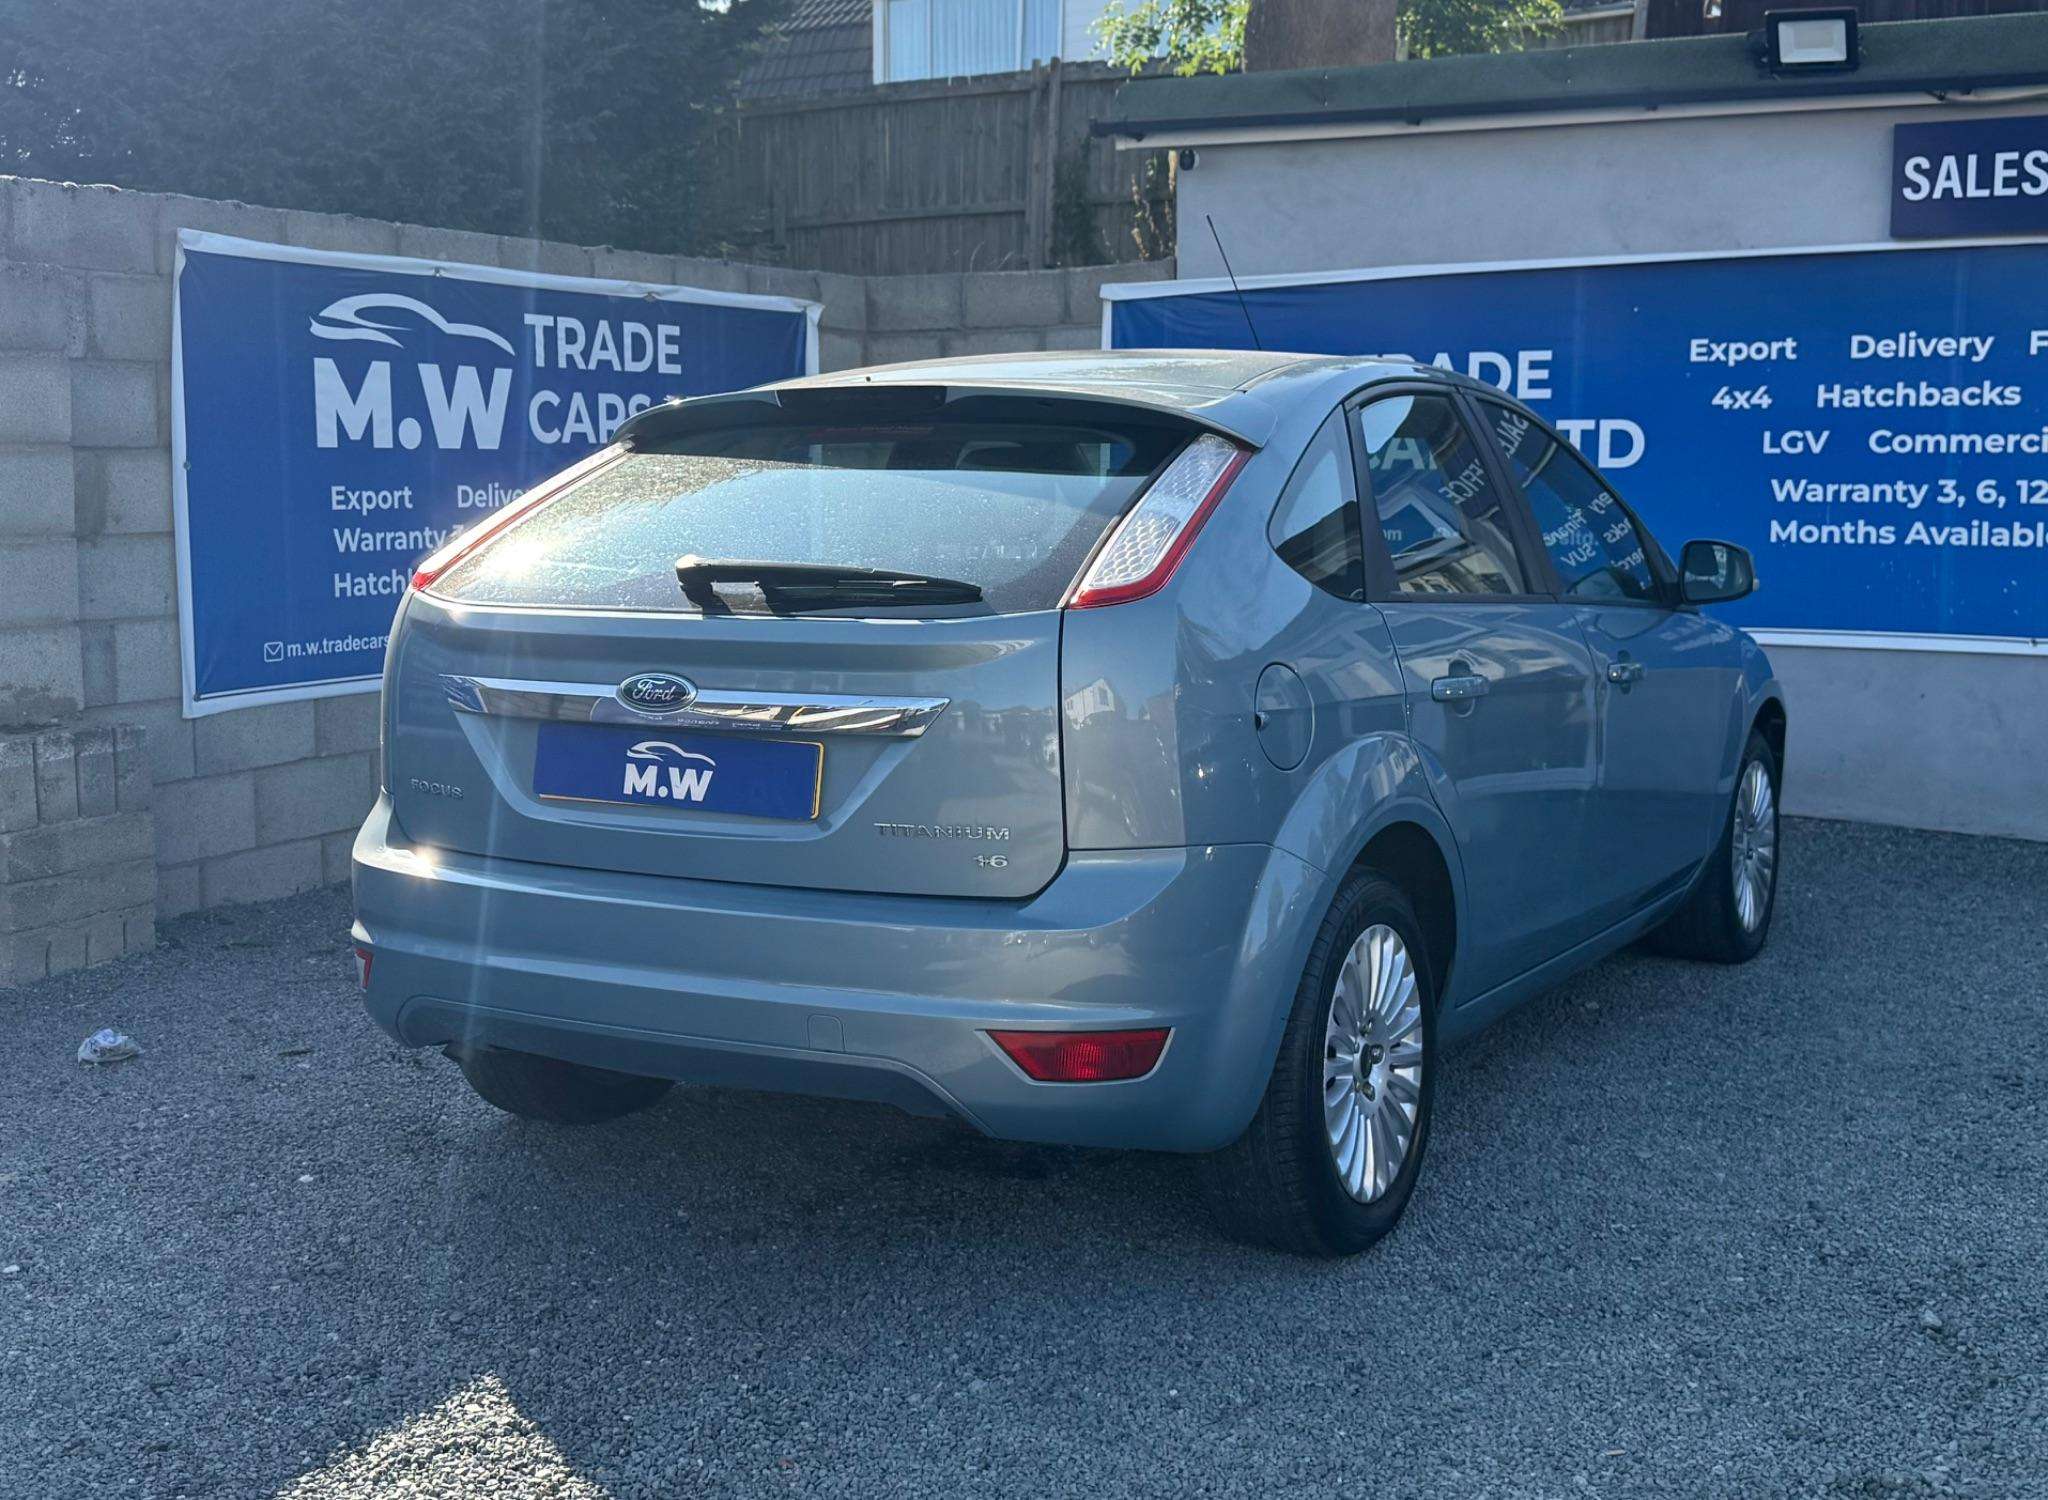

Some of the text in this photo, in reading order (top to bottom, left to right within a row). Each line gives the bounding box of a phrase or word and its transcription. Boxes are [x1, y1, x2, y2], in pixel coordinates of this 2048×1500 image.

[1902, 150, 2048, 201] SALES
[524, 313, 682, 375] TRADE
[1690, 337, 1797, 367] Export
[1850, 331, 1995, 362] Delivery
[313, 357, 513, 450] M.W
[1711, 380, 2022, 409] 4x4 Hatchbacks
[1762, 430, 1830, 454] LGV
[331, 485, 413, 515] Export
[1771, 479, 1929, 509] Warranty
[1936, 479, 1966, 508] 3,
[1975, 479, 2006, 508] 6,
[334, 526, 447, 552] Warranty
[1770, 520, 2048, 548] Months Availabl
[632, 678, 677, 701] Ford
[410, 778, 464, 800] FOCUS
[623, 763, 714, 802] M.W
[873, 822, 1011, 841] TITANIUM
